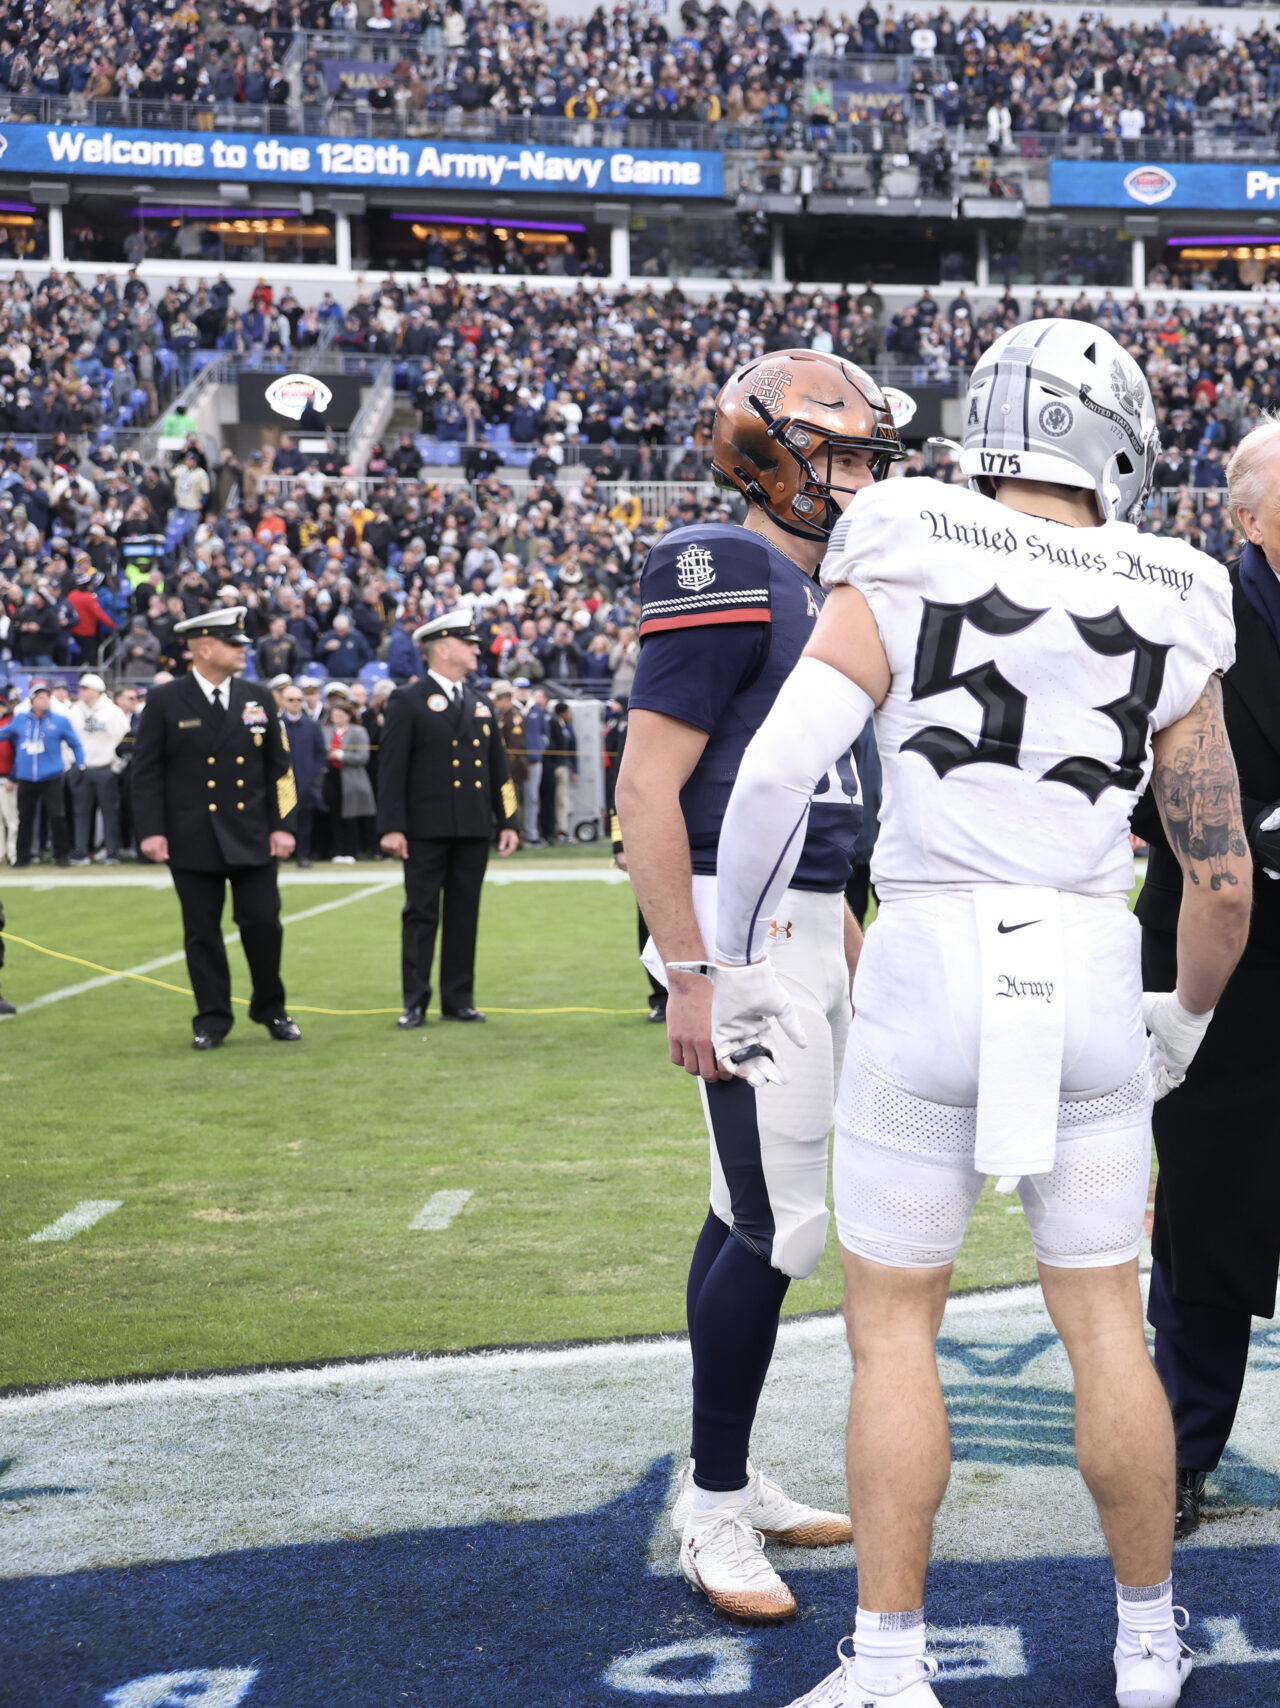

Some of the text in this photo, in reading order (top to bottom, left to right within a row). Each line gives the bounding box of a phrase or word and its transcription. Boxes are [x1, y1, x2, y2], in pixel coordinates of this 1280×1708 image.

[47, 131, 701, 189] Welcome to the 126th Army-Navy Game
[1084, 399, 1112, 418] UNITED
[1112, 411, 1132, 435] STATES
[1110, 425, 1125, 440] 1775
[980, 452, 1021, 475] 1775
[920, 510, 1194, 601] United States Army
[899, 582, 1176, 806] 53
[995, 974, 1054, 1004] Army
